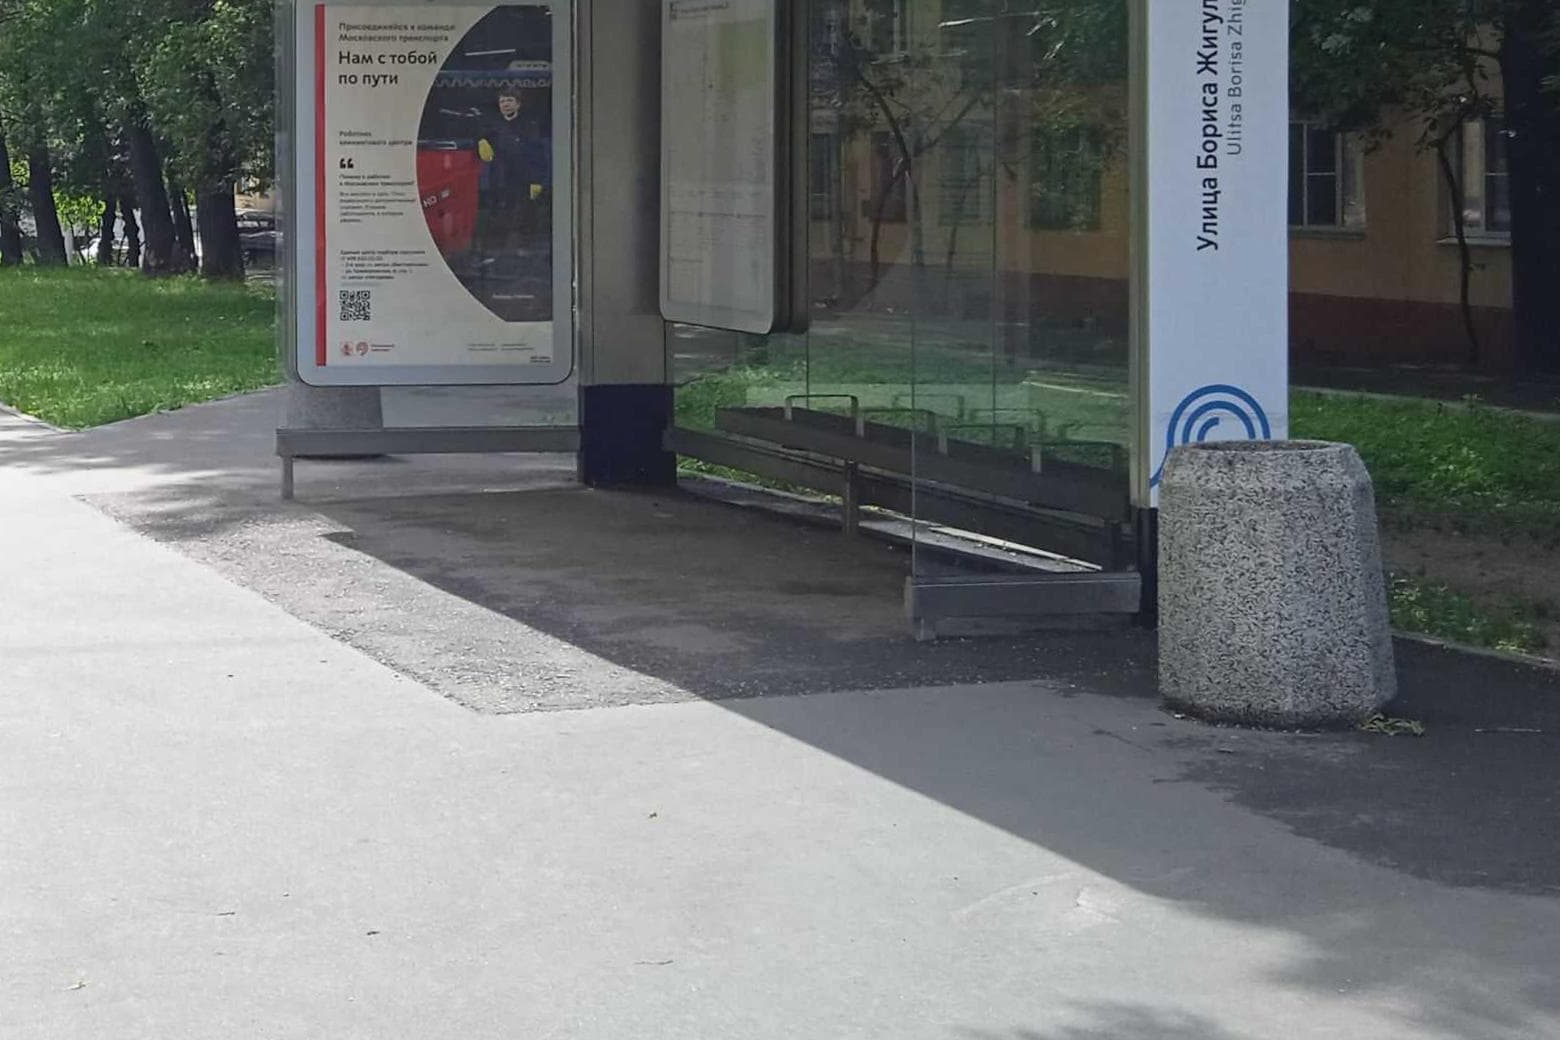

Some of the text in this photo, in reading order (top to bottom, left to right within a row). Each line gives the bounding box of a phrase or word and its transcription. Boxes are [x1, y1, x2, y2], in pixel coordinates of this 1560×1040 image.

[339, 50, 438, 64] Нам с тобой
[339, 74, 399, 87] по пути
[1226, 42, 1243, 97] Borisa
[1196, 83, 1222, 169] Бориса
[1226, 104, 1243, 155] Ulitsa
[1196, 177, 1220, 251] Улица
